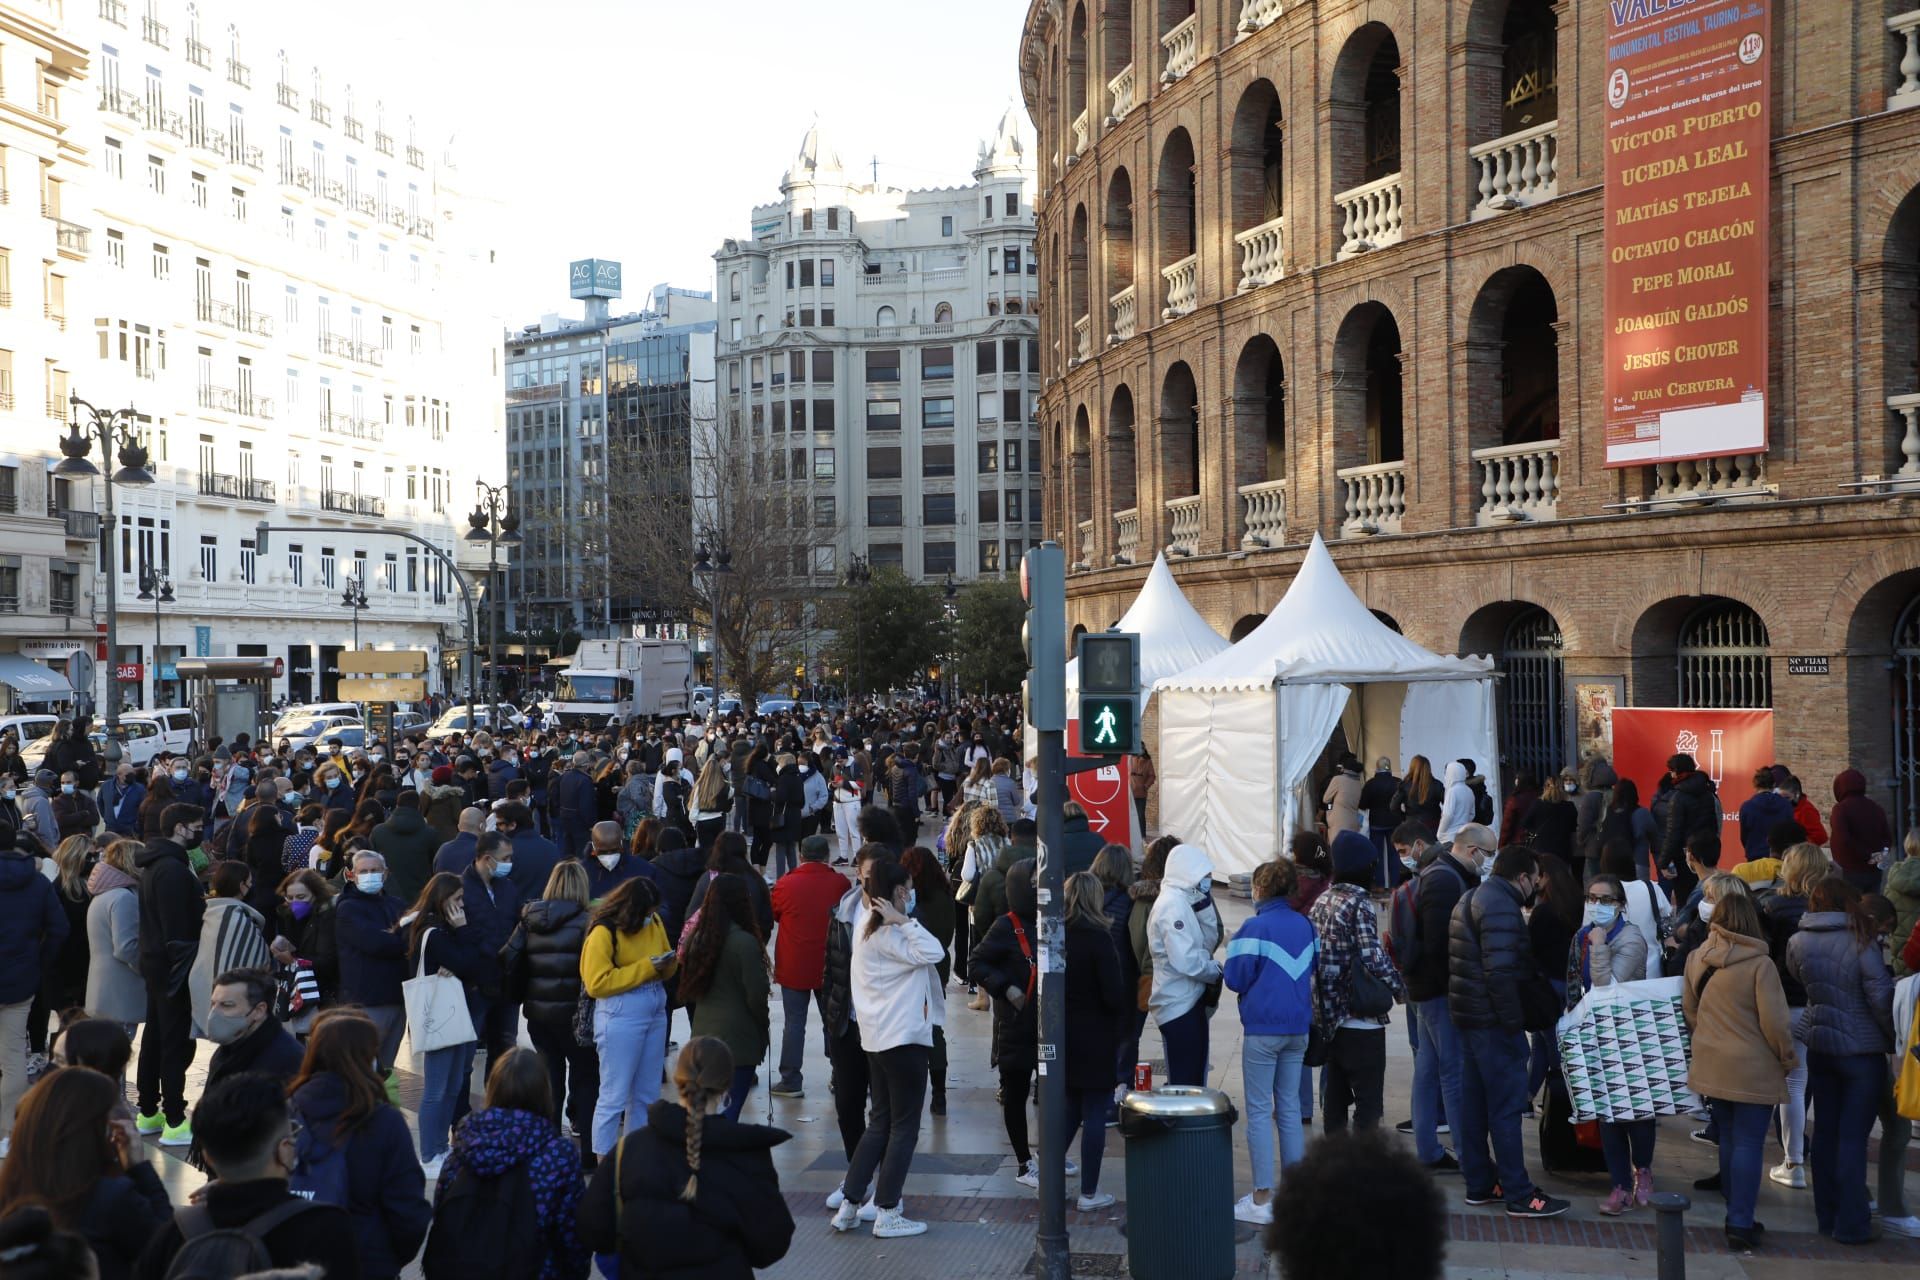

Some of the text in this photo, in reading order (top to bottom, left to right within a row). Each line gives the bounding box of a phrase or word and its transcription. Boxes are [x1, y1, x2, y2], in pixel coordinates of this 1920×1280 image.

[1610, 31, 1662, 64] MONUMENTAL
[1664, 18, 1700, 44] FESTIVAL
[1703, 6, 1739, 31] TAURINO
[1613, 74, 1624, 98] 5
[1610, 118, 1625, 129] para
[1671, 97, 1700, 109] diestros
[1702, 89, 1728, 101] figuras
[1728, 84, 1741, 94] del
[1610, 101, 1762, 154] VÍCTOR PUERTO
[1621, 140, 1748, 186] UCEDA LEAL
[1615, 182, 1752, 226] MATÍAS TEJELA
[1612, 217, 1755, 263] OCTAVIO CHACÓN
[572, 264, 590, 279] AC
[597, 264, 618, 279] AC
[1632, 261, 1734, 294] PEPE MORAL
[1615, 294, 1749, 334] JOAQUÍN GALDÓS
[1623, 340, 1739, 371] JESÚS CHOVER
[1632, 388, 1662, 402] JUAN
[1667, 377, 1736, 397] CERVERA
[1553, 632, 1561, 644] 14
[116, 666, 137, 678] GAES
[1790, 665, 1828, 673] CARTELES
[1529, 1197, 1546, 1211] N
